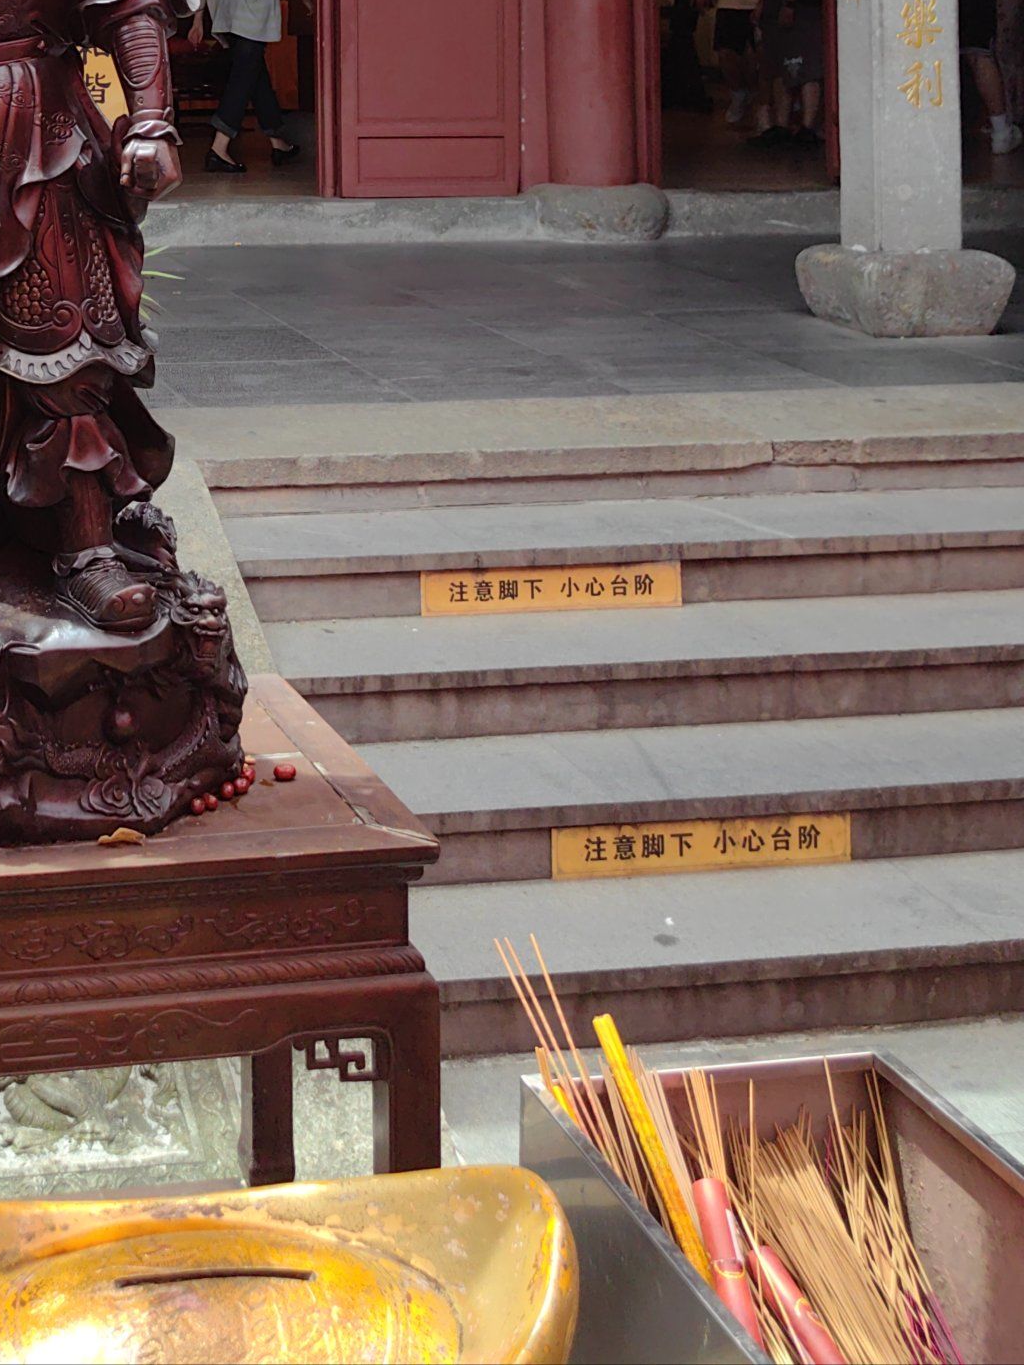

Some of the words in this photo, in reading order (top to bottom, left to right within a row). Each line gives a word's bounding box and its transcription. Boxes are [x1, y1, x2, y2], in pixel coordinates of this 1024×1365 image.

[449, 578, 544, 603] 注意脚下
[560, 574, 655, 598] 小心台阶
[584, 833, 693, 863] 注意脚下
[713, 824, 822, 856] 小心台阶
